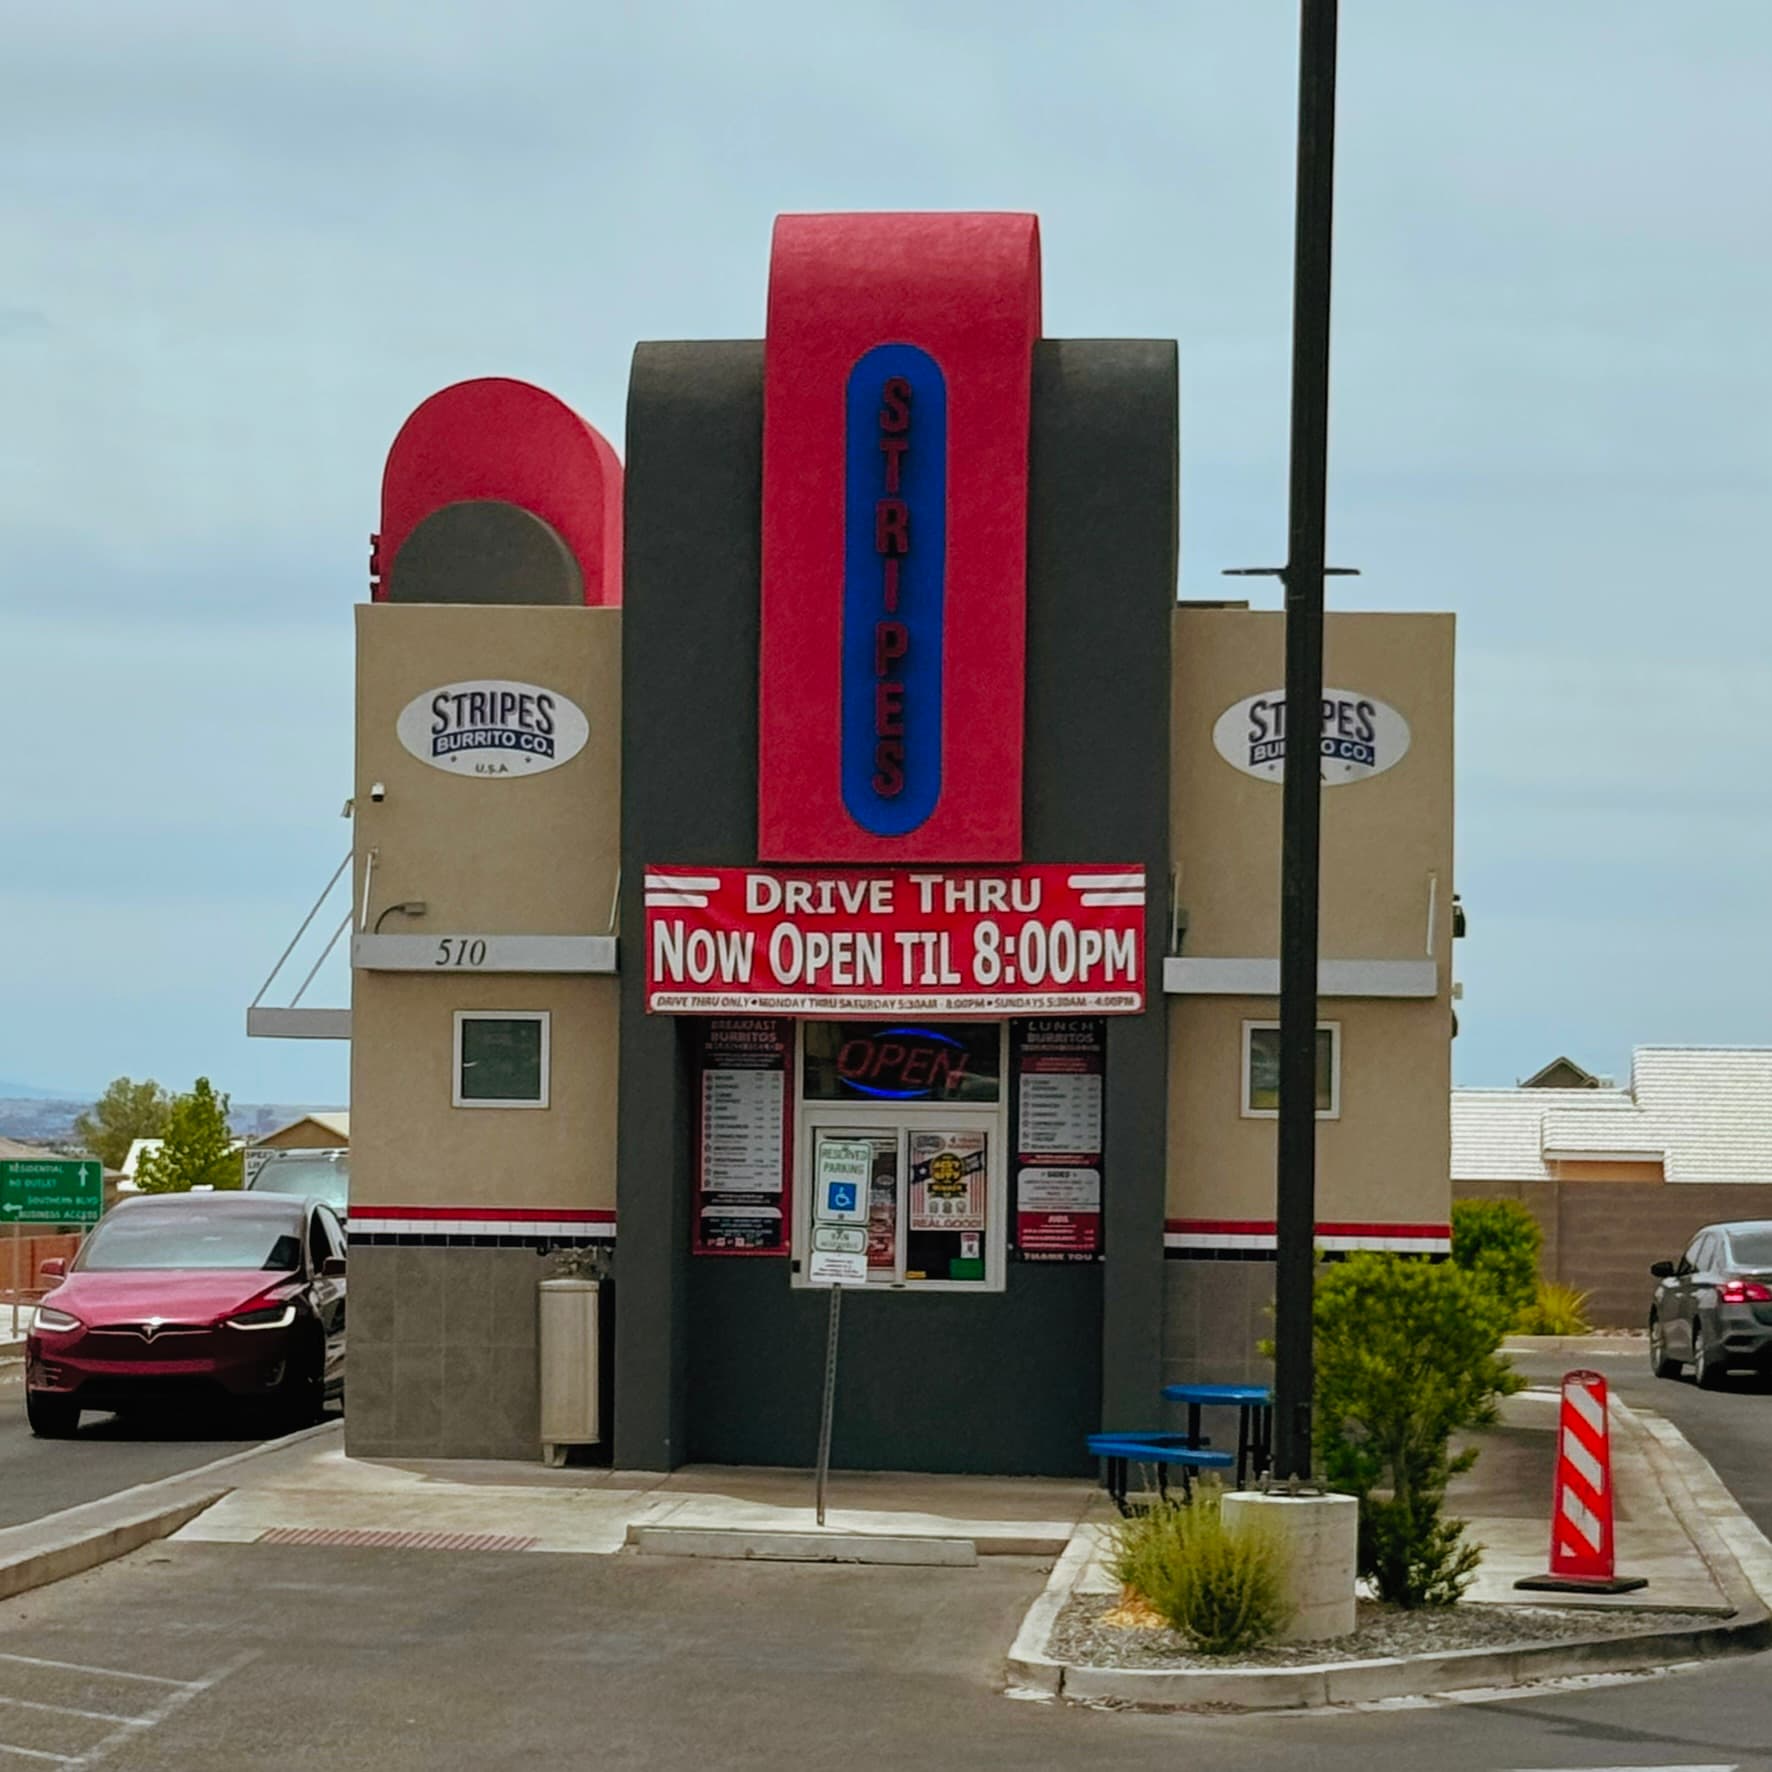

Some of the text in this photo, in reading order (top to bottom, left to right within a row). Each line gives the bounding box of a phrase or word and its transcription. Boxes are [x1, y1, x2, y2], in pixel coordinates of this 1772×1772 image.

[873, 375, 913, 799] STRIPES
[432, 692, 556, 736] STRIPES
[1248, 699, 1376, 744] STPES
[436, 731, 553, 755] BURRITO CO.
[745, 873, 1042, 914] DRIVE THRU
[435, 939, 487, 966] 510
[652, 919, 1137, 986] NOW OPEN TIL 8:00PM
[657, 996, 688, 1007] DRIVE
[690, 996, 719, 1007] THRU
[721, 996, 749, 1007] ONLY
[758, 997, 807, 1009] MONDAY
[808, 997, 837, 1009] THRU
[838, 997, 895, 1009] SATURDAY
[993, 997, 1044, 1009] SUNDAYS
[1028, 1020, 1095, 1032] LUNCH
[836, 1039, 972, 1091] OPEN
[823, 1162, 865, 1175] PARKING
